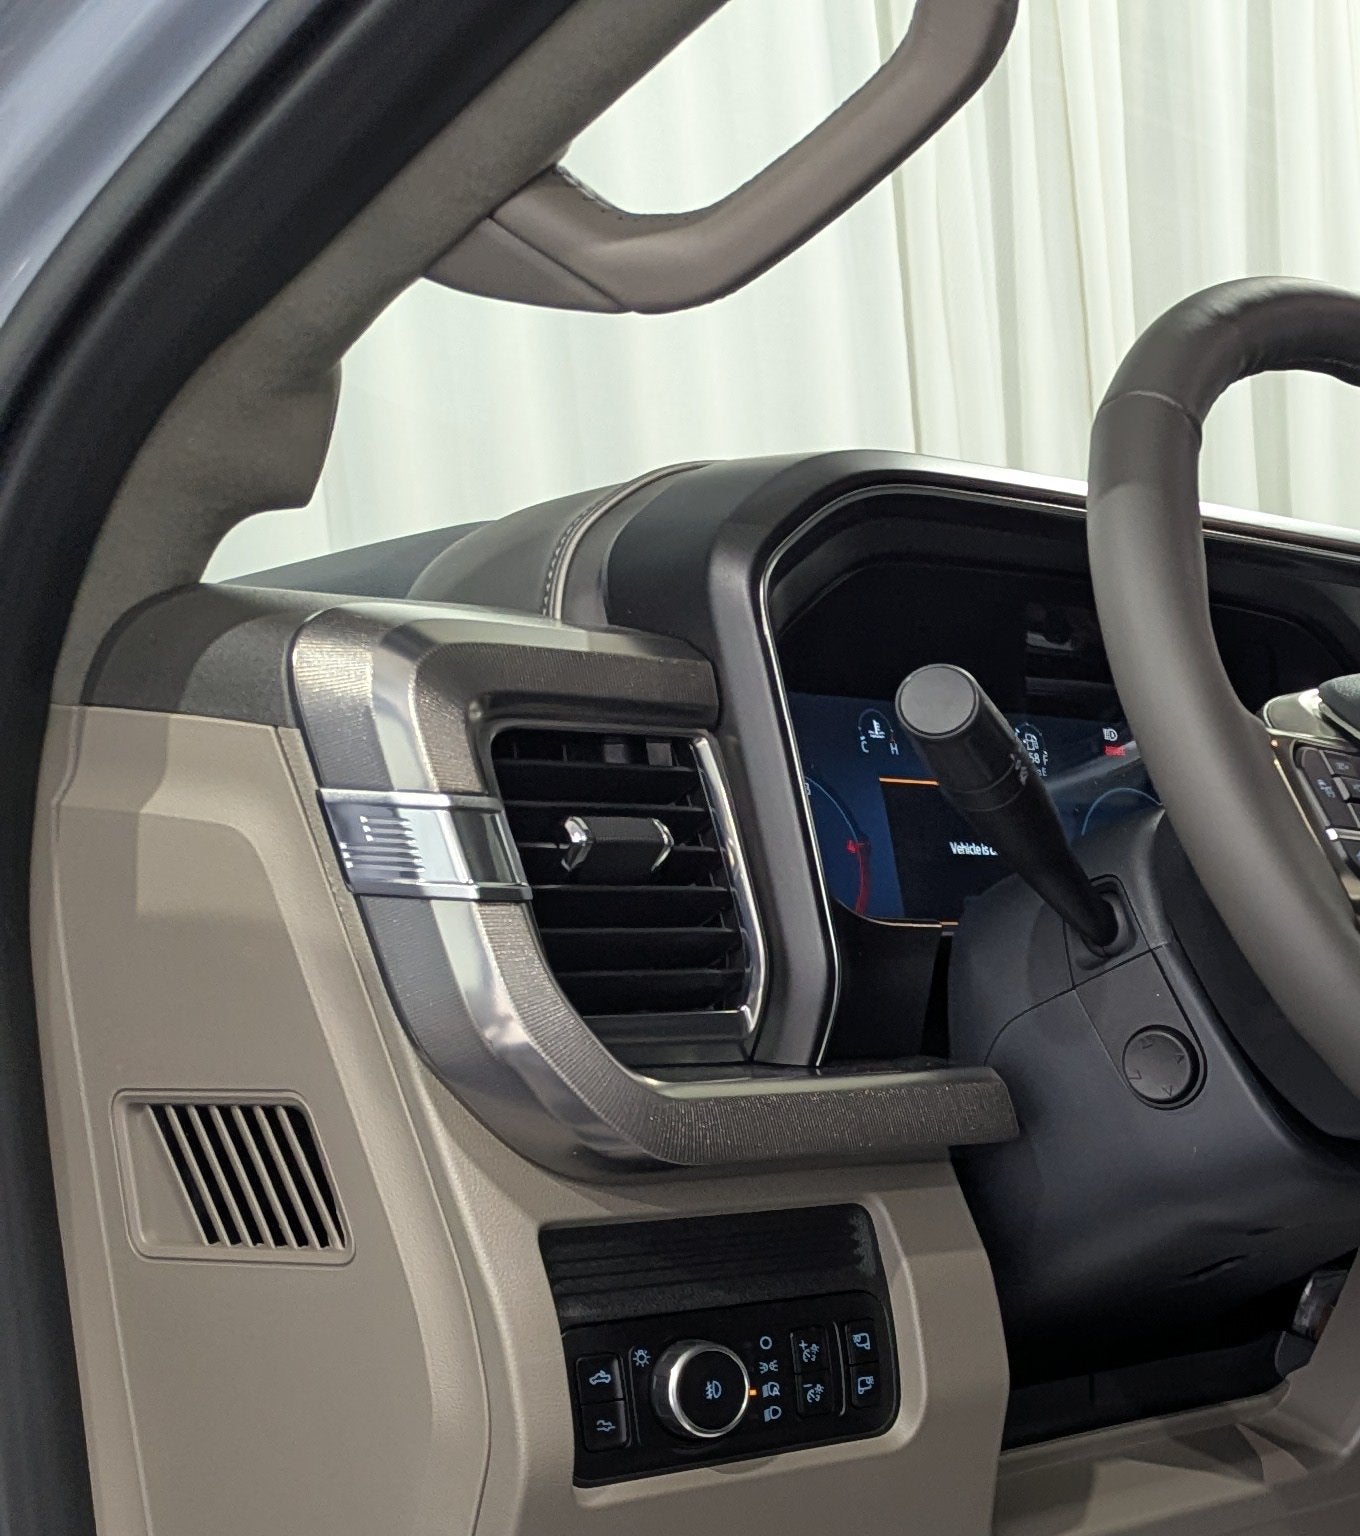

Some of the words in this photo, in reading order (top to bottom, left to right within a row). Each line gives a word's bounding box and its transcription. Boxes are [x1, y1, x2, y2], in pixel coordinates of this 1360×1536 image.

[860, 740, 870, 753] C
[889, 742, 900, 756] H
[948, 841, 981, 856] Vehicle
